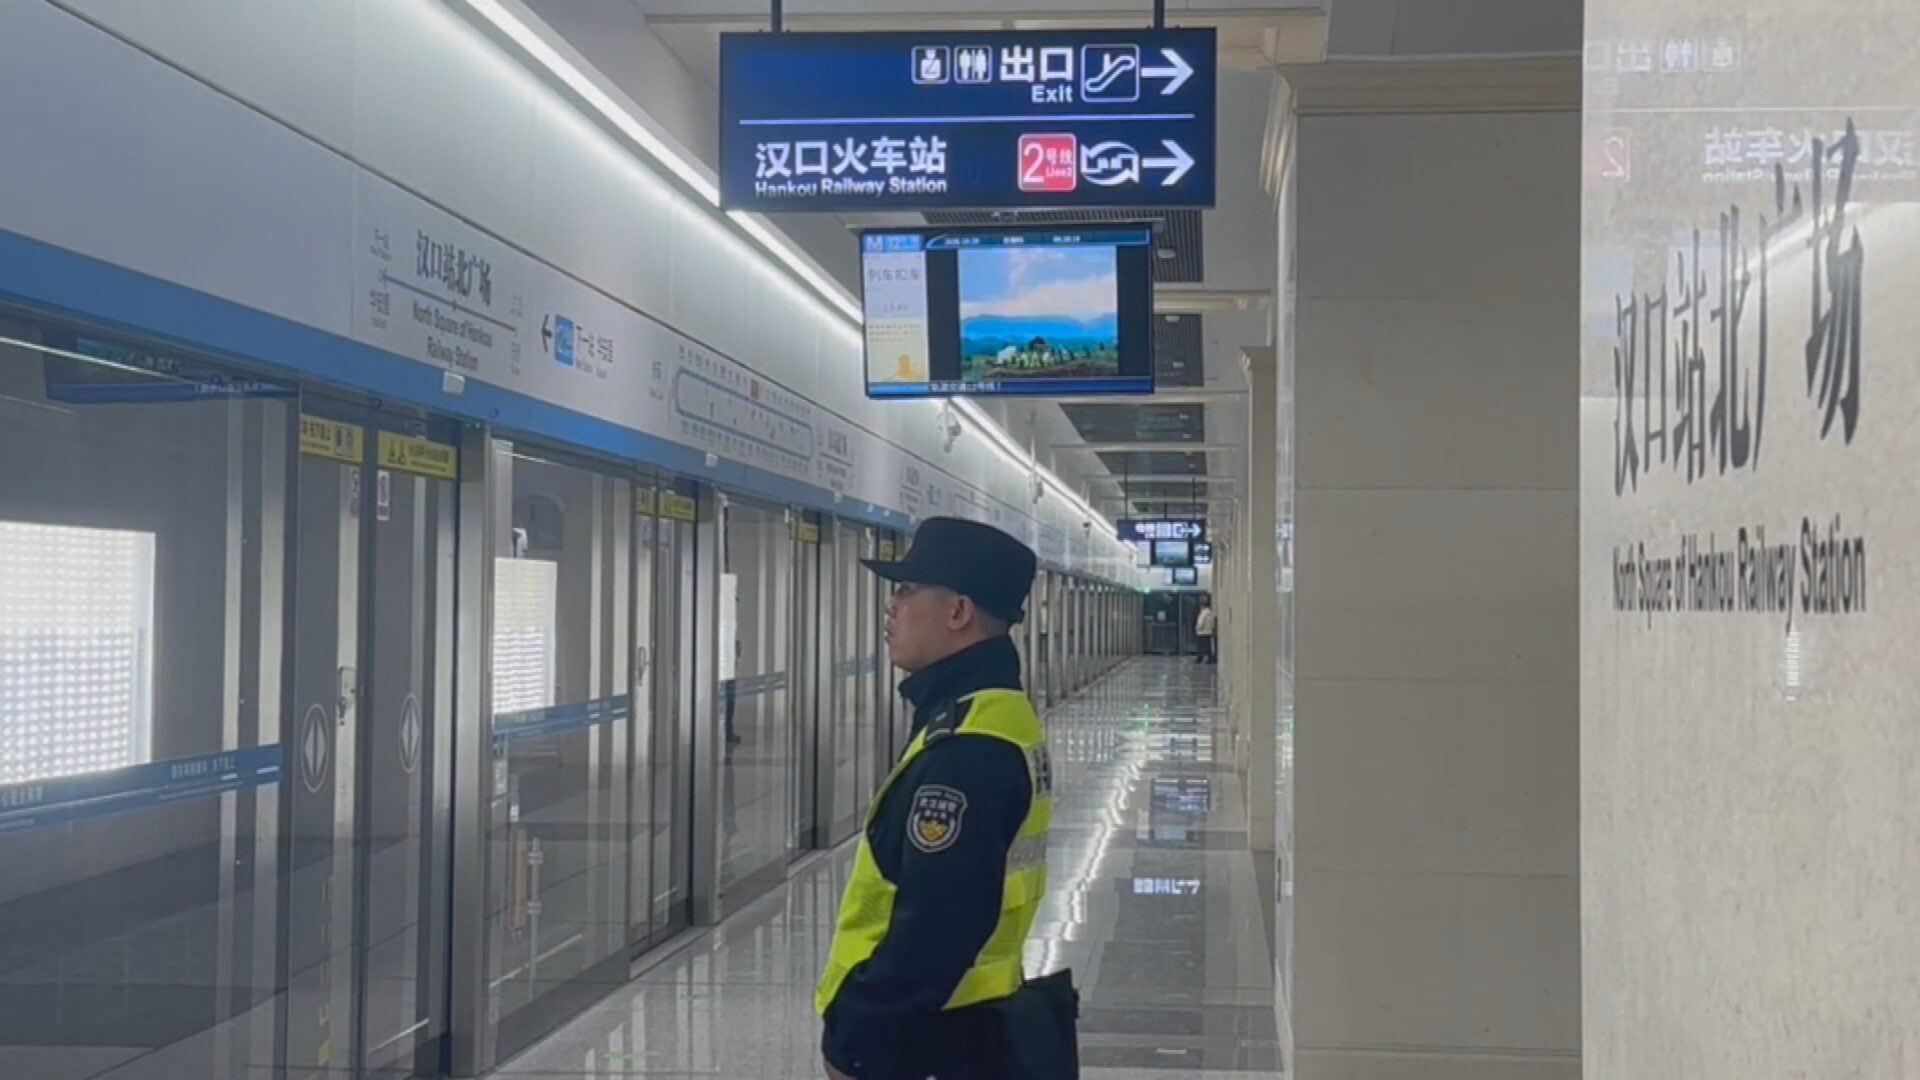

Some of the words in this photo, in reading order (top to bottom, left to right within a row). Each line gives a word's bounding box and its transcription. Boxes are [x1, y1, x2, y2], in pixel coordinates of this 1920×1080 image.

[1000, 46, 1073, 82] 出口
[1032, 85, 1073, 103] Exit
[756, 136, 947, 178] 汉口火车站
[755, 180, 817, 199] Hankou
[821, 177, 885, 198] Railway
[889, 175, 947, 194] Station
[415, 228, 492, 307] 汉口站北广场
[1613, 115, 1864, 498] 汉口站北广场
[1612, 544, 1636, 611] North
[1638, 540, 1672, 631] Square
[1674, 534, 1686, 612] of
[1688, 531, 1735, 612] Hankou
[1738, 525, 1797, 638] Railway
[1800, 512, 1867, 614] Station
